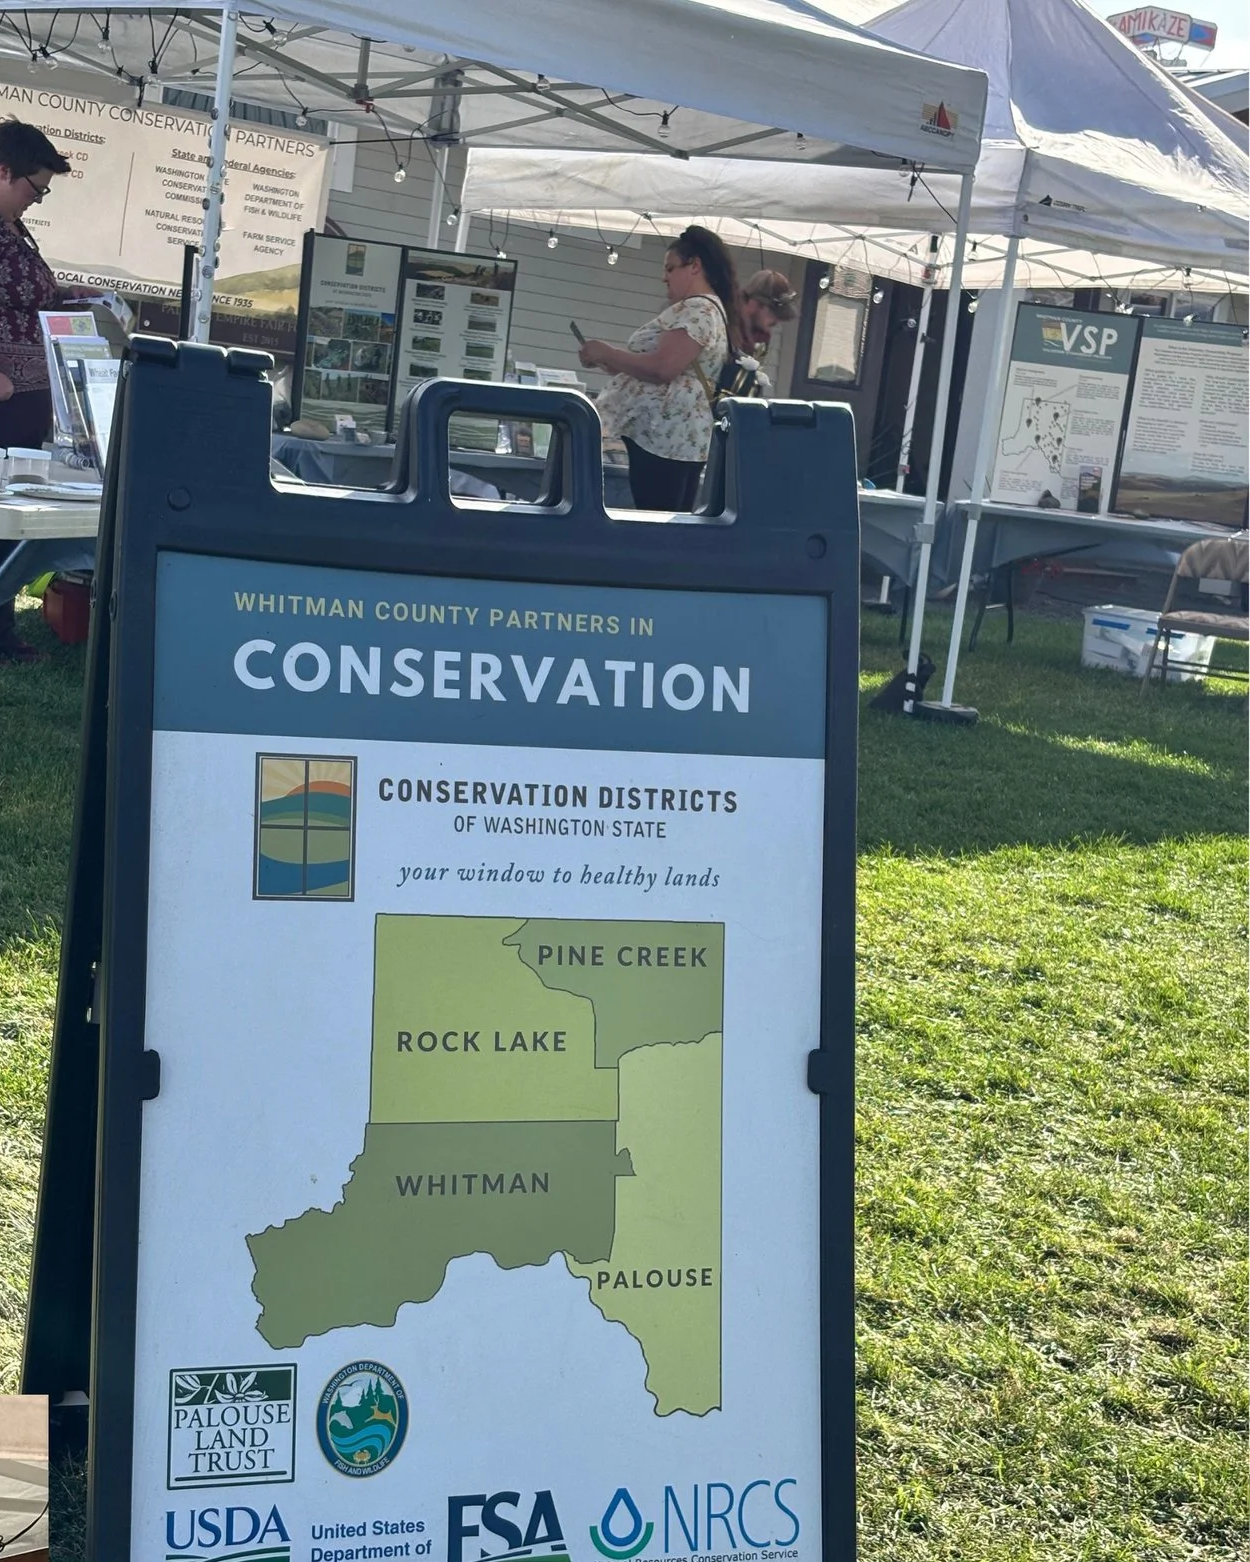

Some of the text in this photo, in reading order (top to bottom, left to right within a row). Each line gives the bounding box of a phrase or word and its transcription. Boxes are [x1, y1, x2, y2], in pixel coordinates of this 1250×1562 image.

[37, 92, 315, 157] COUNTY PARTNERS
[76, 152, 89, 161] CD
[172, 148, 196, 162] State
[71, 170, 84, 179] CD
[155, 165, 205, 181] WASHINGTON
[252, 183, 300, 198] WASHINGTON
[244, 194, 304, 211] DEPARTMENT OF
[244, 205, 260, 215] FISH
[268, 210, 303, 222] WILDLIFE
[145, 209, 179, 223] NATURAL
[243, 231, 296, 247] FARM SERVICE
[254, 246, 285, 256] AGENCY
[52, 270, 168, 296] LOCAL CONSERVATION
[233, 297, 254, 308] 1935
[216, 312, 286, 331] EMPIRE FAIR
[1060, 322, 1118, 355] VSP
[234, 592, 655, 637] WHITMAN COUNTY PARTNERS IN
[233, 639, 751, 714] CONSERVATION
[378, 777, 739, 814] CONSERVATION DISTRICTS
[453, 816, 667, 839] OF WASHINGTON STATE
[396, 862, 721, 892] your window to healthy lands
[537, 945, 709, 969] PINE CREEK
[396, 1030, 568, 1054] ROCK LAKE
[396, 1172, 550, 1197] WHITMAN
[596, 1268, 713, 1290] PALOUSE
[322, 1363, 405, 1404] WASHINGTON DEPARTMENT OF
[174, 1403, 291, 1429] PALOUSE
[195, 1427, 269, 1450] LAND
[188, 1449, 275, 1473] TRUST
[362, 1456, 390, 1475] WILDLIFE
[165, 1504, 292, 1550] USDA
[664, 1478, 801, 1554] NRCS
[311, 1518, 425, 1540] United States
[415, 1540, 432, 1555] of
[761, 1549, 799, 1560] Service
